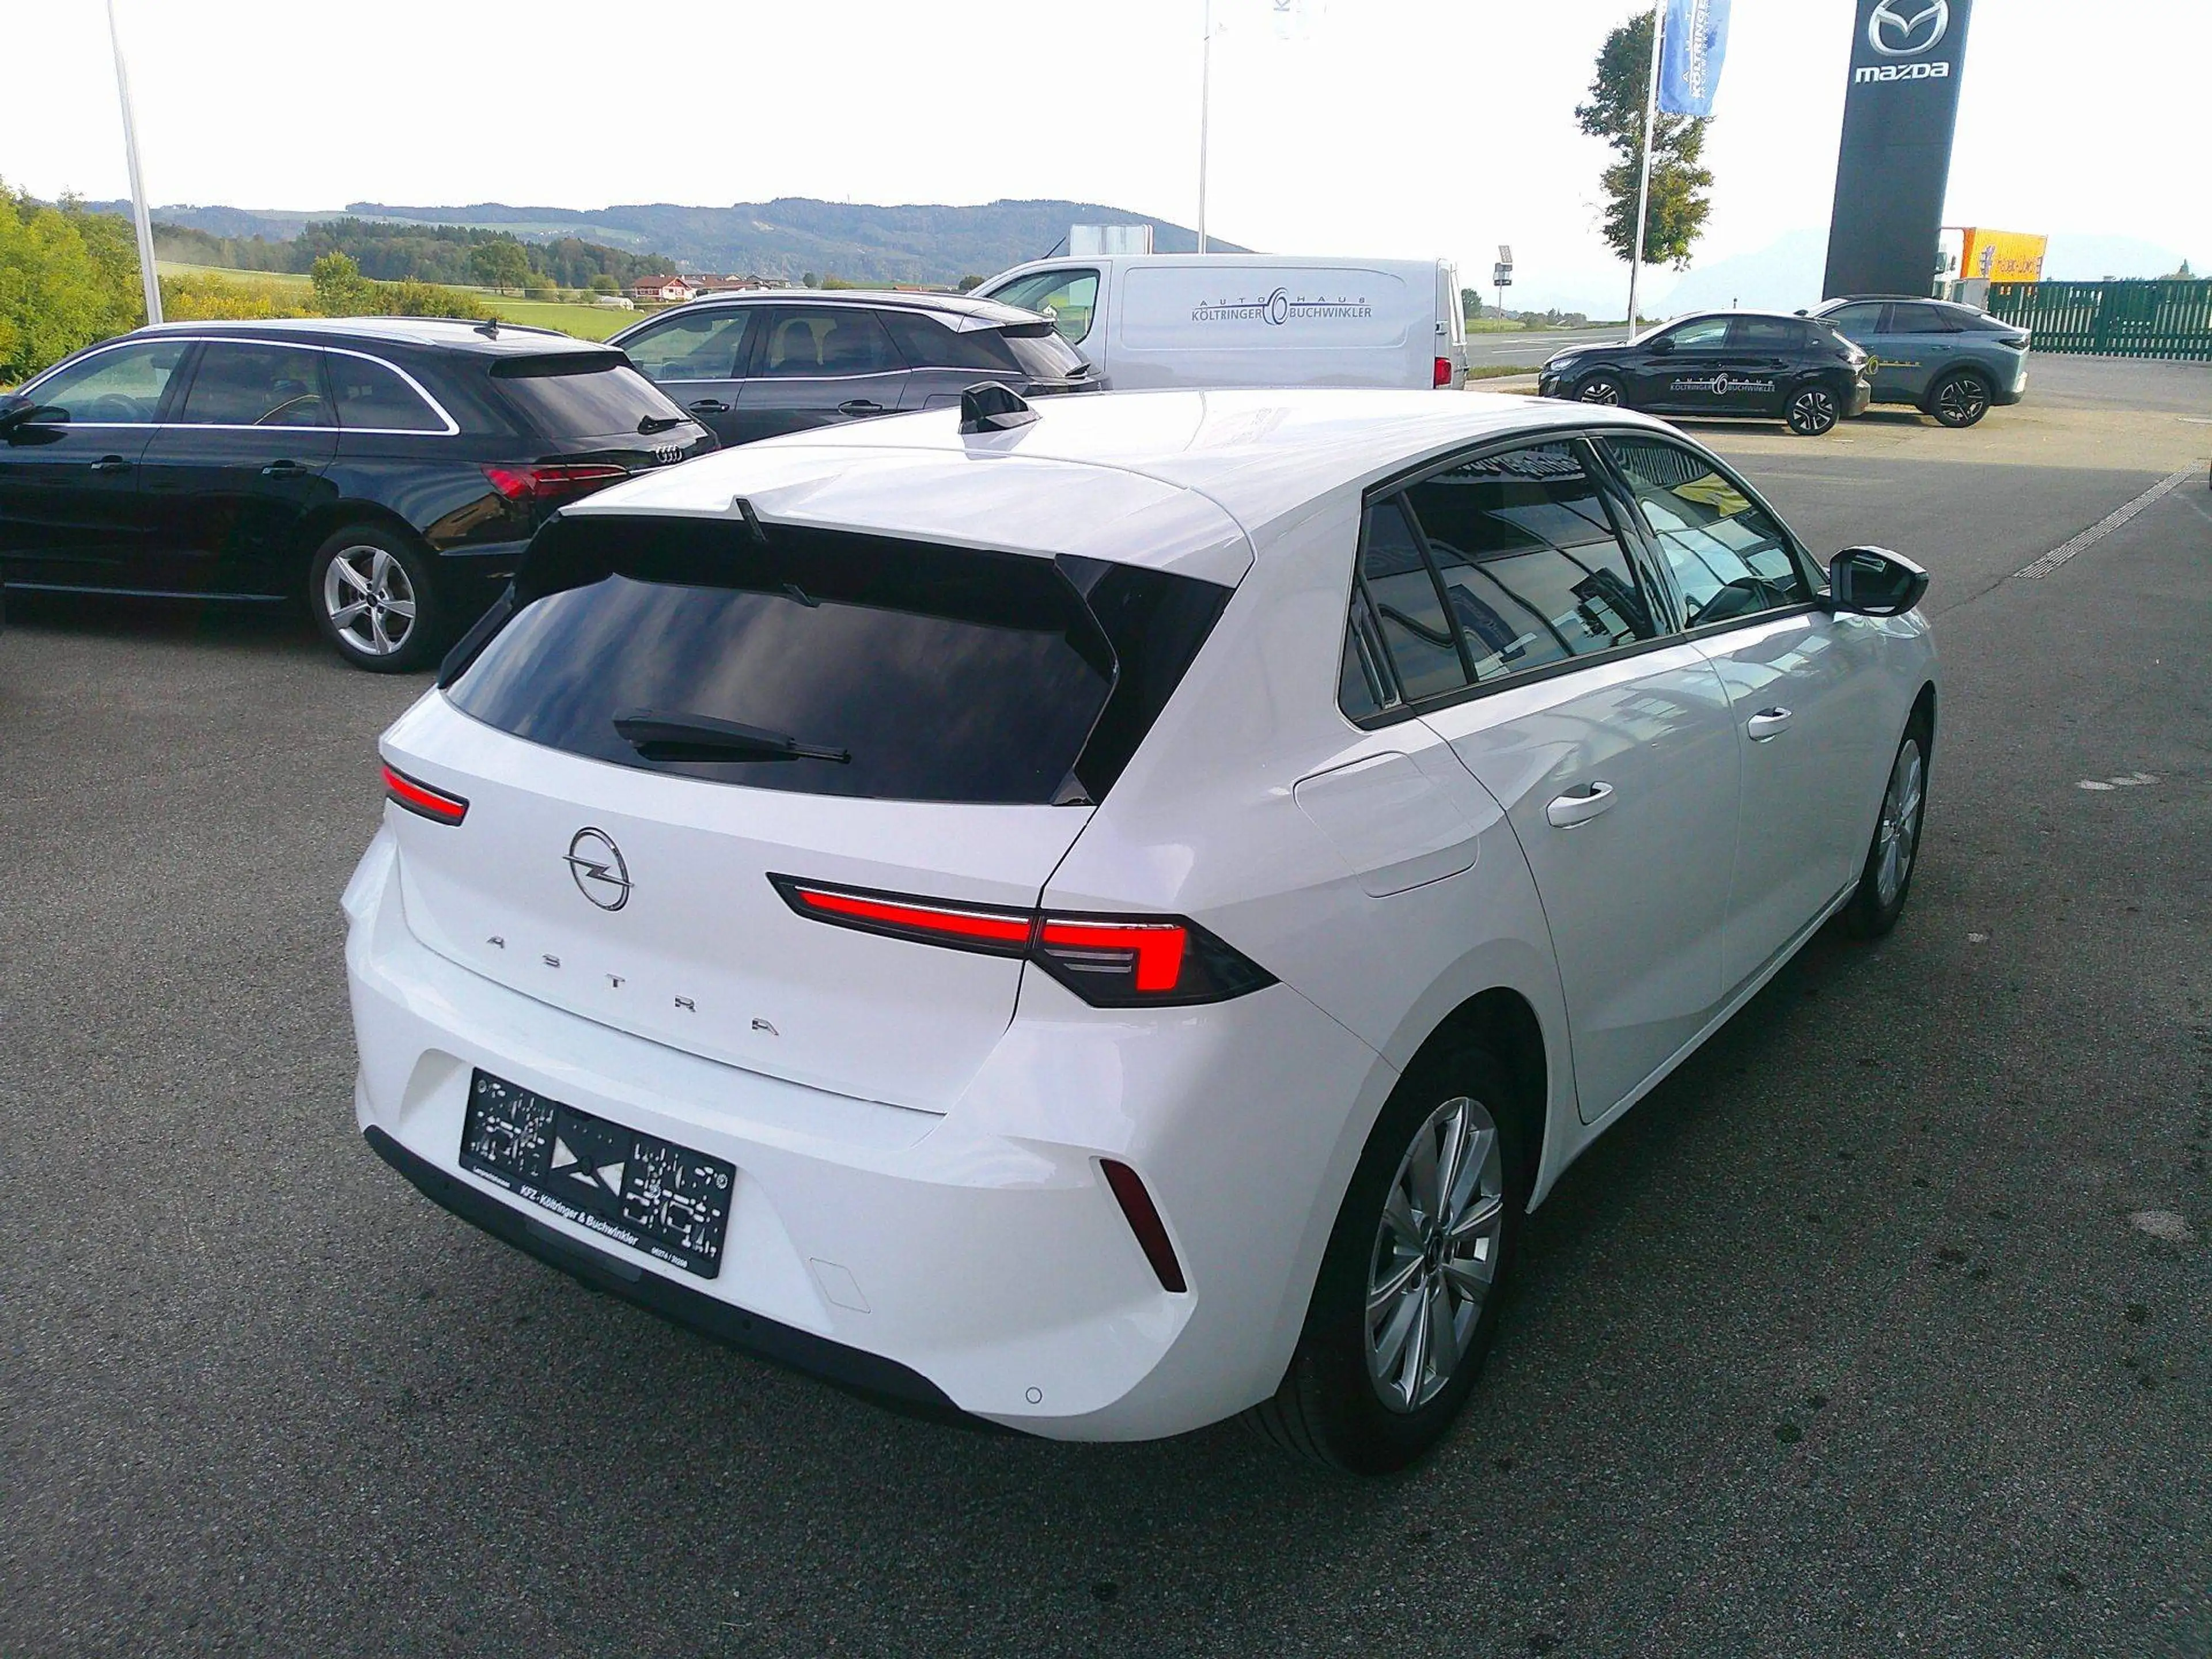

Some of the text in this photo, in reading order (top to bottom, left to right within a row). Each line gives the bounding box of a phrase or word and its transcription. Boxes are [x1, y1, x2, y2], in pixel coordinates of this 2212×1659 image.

[1192, 307, 1372, 321] KÖLTRINGER BUCHWINKLER
[578, 1212, 585, 1224] &
[586, 1215, 639, 1245] Buchwinkler
